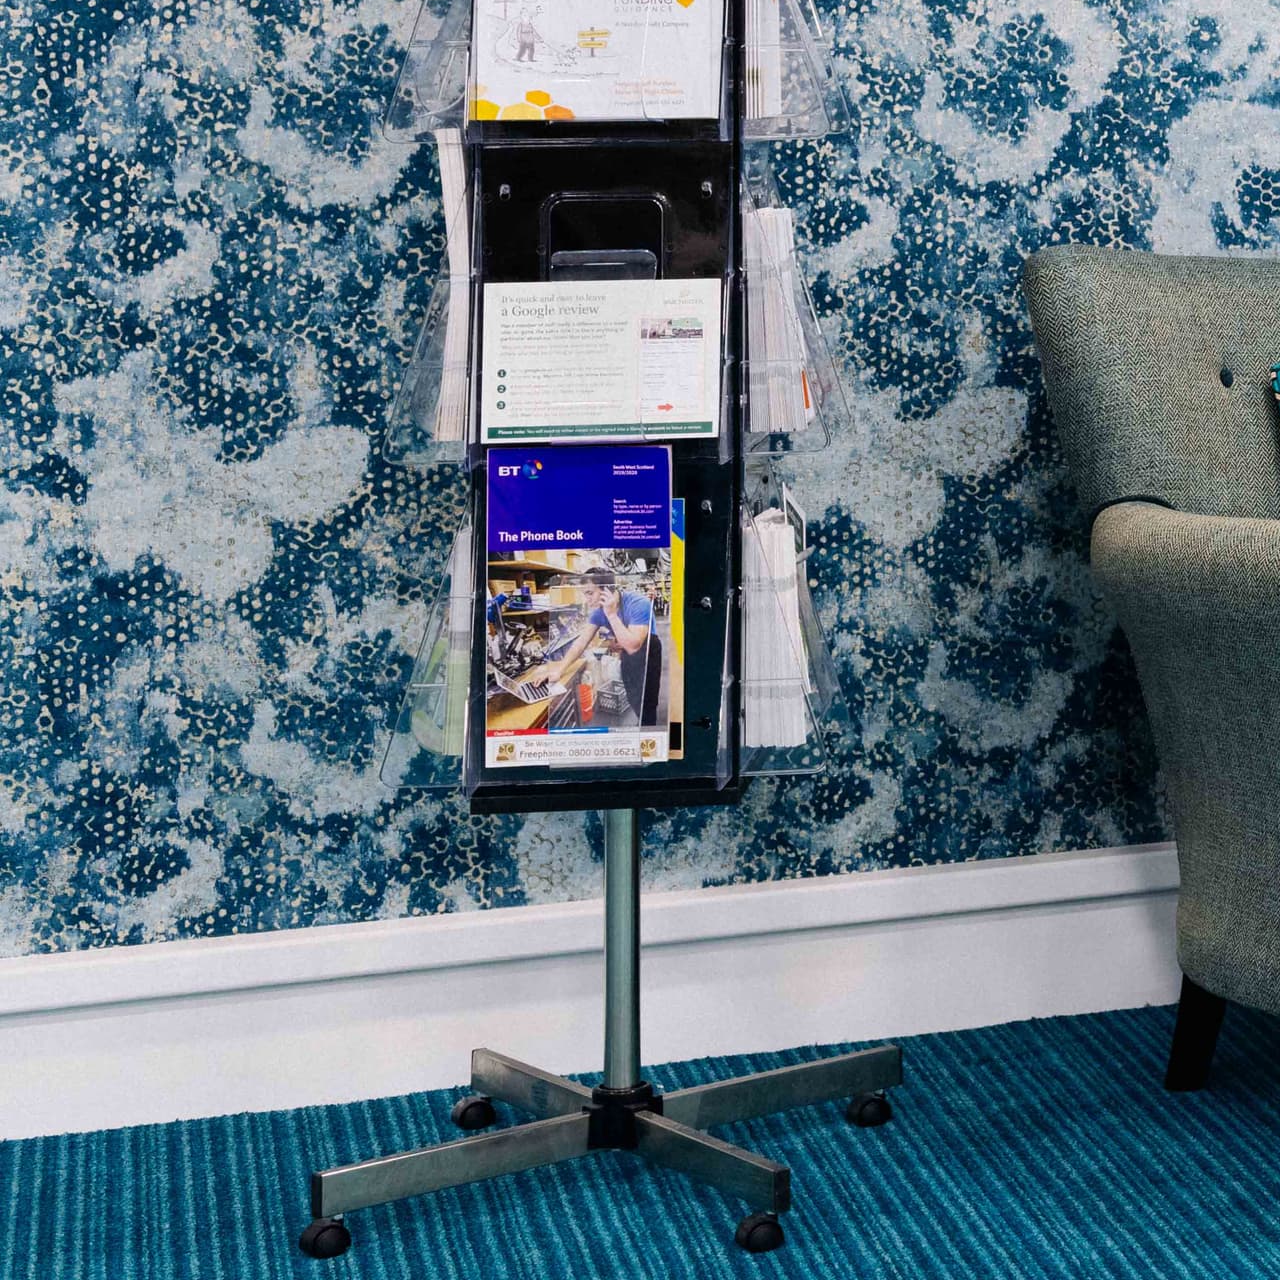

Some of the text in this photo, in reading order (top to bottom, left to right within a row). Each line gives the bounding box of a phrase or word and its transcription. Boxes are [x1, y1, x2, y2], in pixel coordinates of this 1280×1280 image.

[515, 294, 537, 305] quick
[539, 294, 554, 303] and
[585, 293, 606, 302] leave
[501, 303, 600, 318] a Google review
[498, 465, 521, 477] BT
[498, 529, 584, 543] The Phone Book
[568, 748, 592, 758] 0800
[594, 748, 611, 757] 031
[613, 747, 637, 757] 6621
